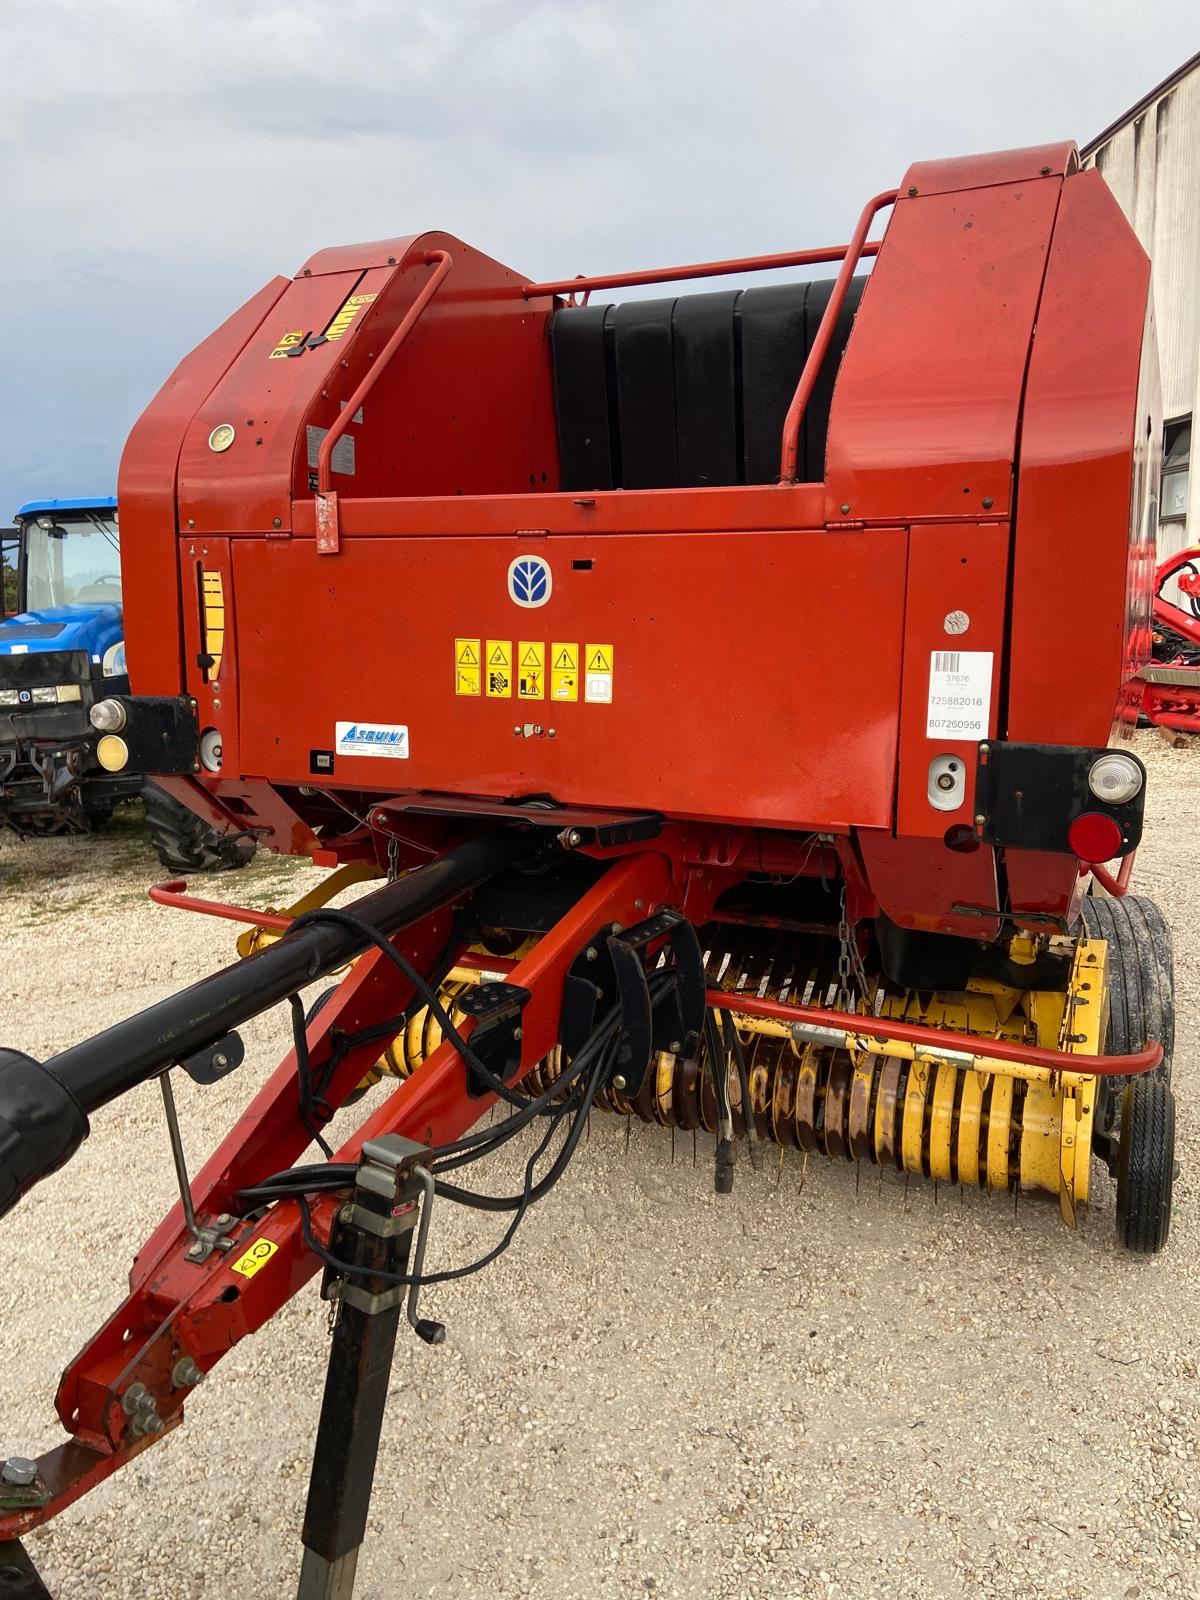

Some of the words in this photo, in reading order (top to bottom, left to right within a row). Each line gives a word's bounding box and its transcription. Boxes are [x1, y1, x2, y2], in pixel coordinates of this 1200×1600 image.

[354, 294, 376, 303] STOP
[945, 675, 970, 683] 37676
[931, 696, 983, 706] 725882016
[928, 719, 981, 730] 807260956
